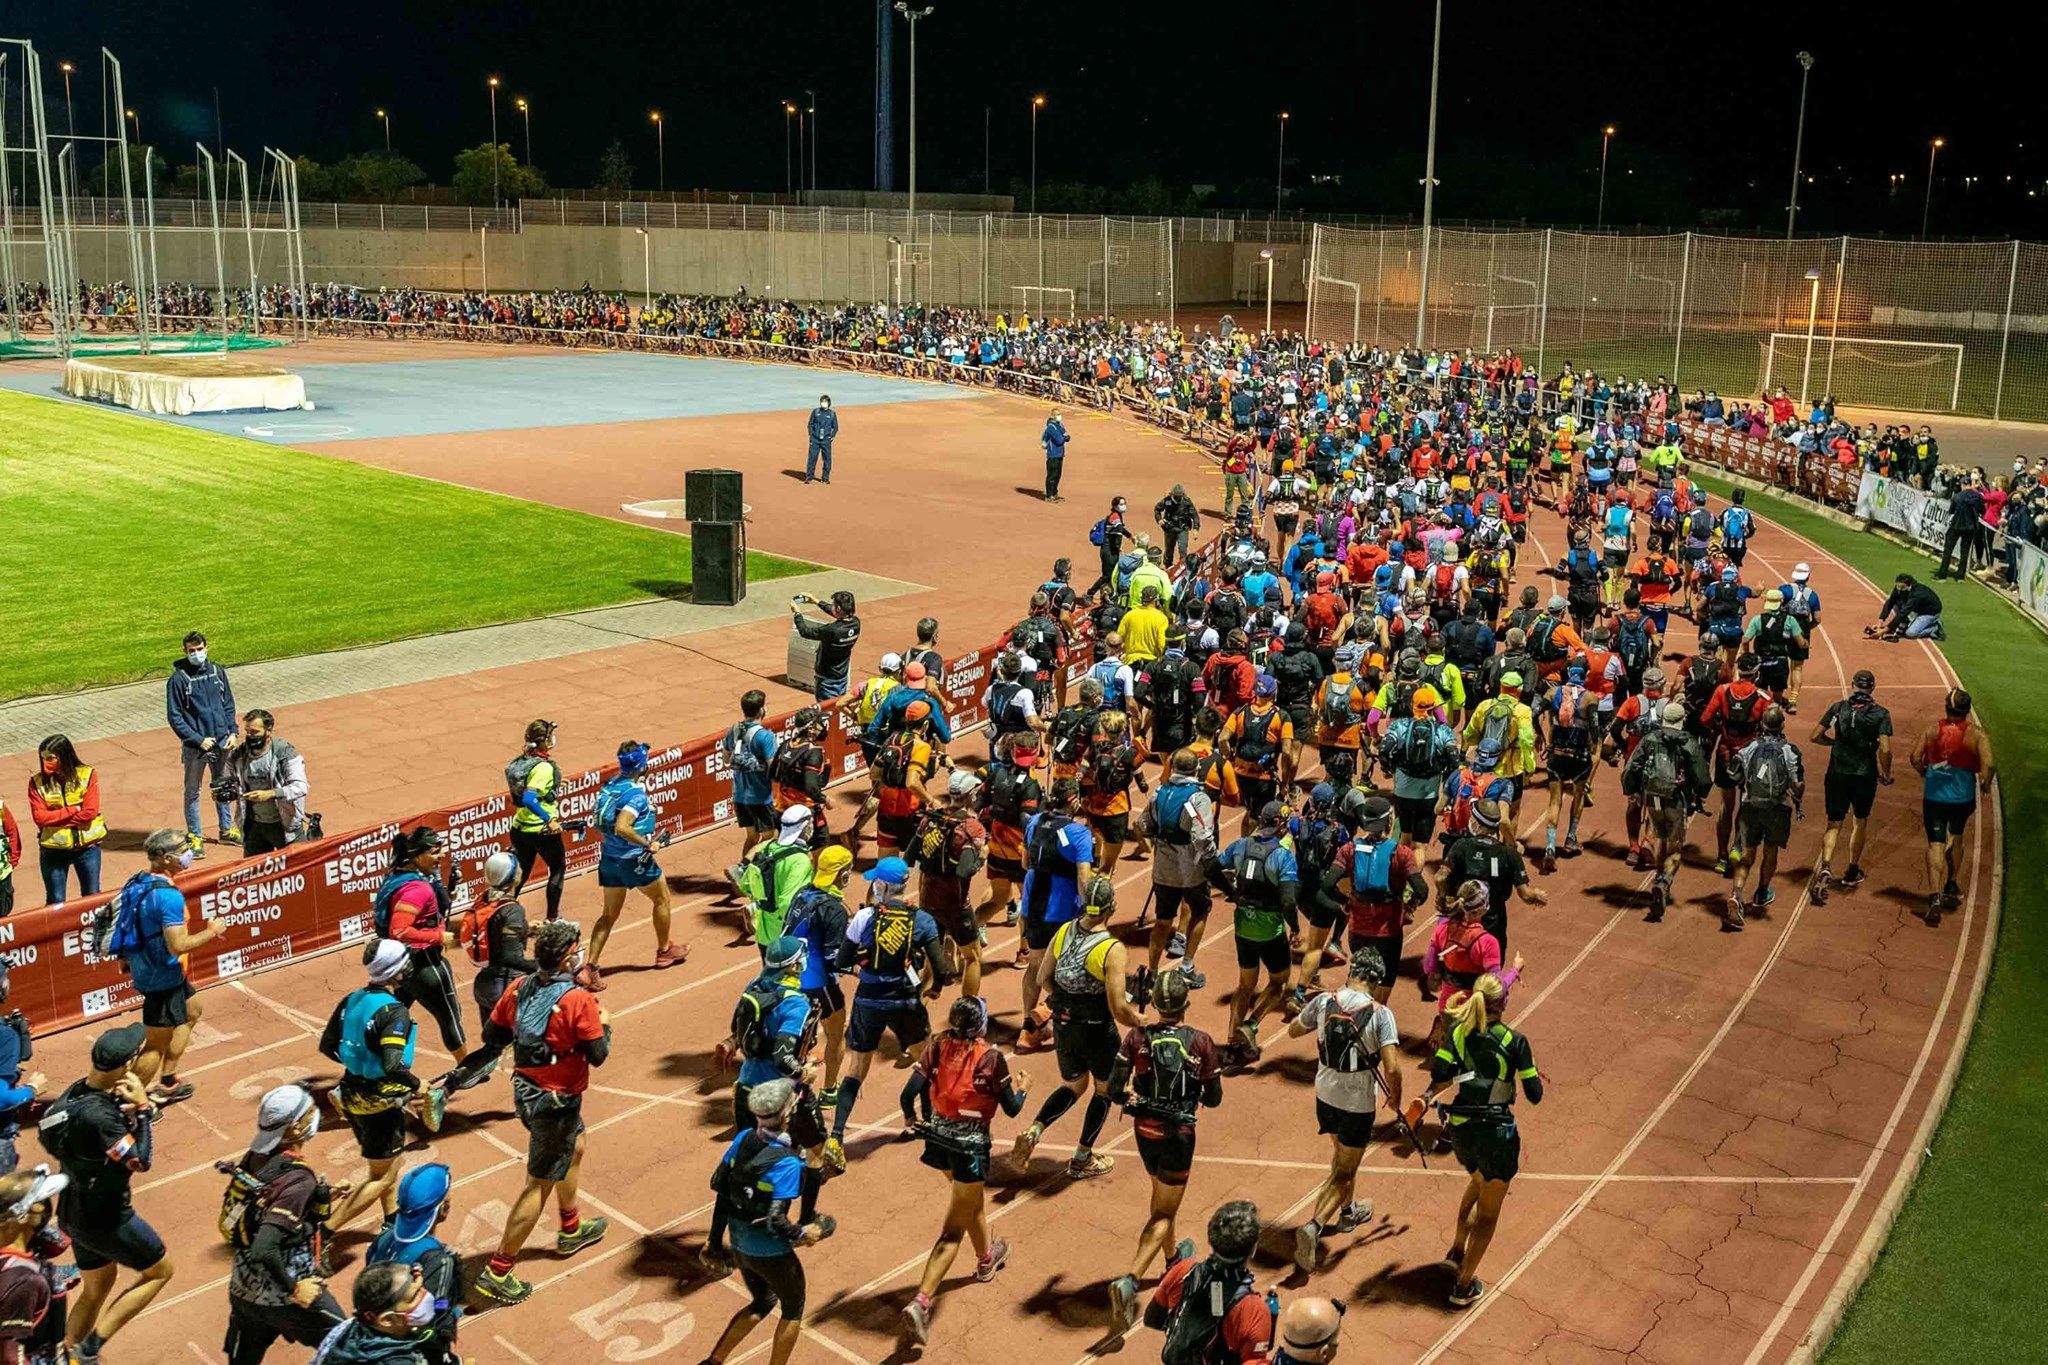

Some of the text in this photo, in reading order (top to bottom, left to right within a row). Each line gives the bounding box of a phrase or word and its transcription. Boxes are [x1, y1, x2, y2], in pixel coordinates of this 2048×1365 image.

[637, 763, 693, 792] SCENARIO
[448, 795, 506, 827] CASTELLÓN
[648, 789, 678, 805] ORTIVO
[338, 823, 400, 857] CASTELLÓN
[437, 816, 513, 853] ESCENARI
[217, 855, 287, 889] CASTELLÓN
[324, 848, 394, 887] ESCEN
[200, 873, 305, 920] ESCENARIO
[569, 1279, 696, 1363] 5
